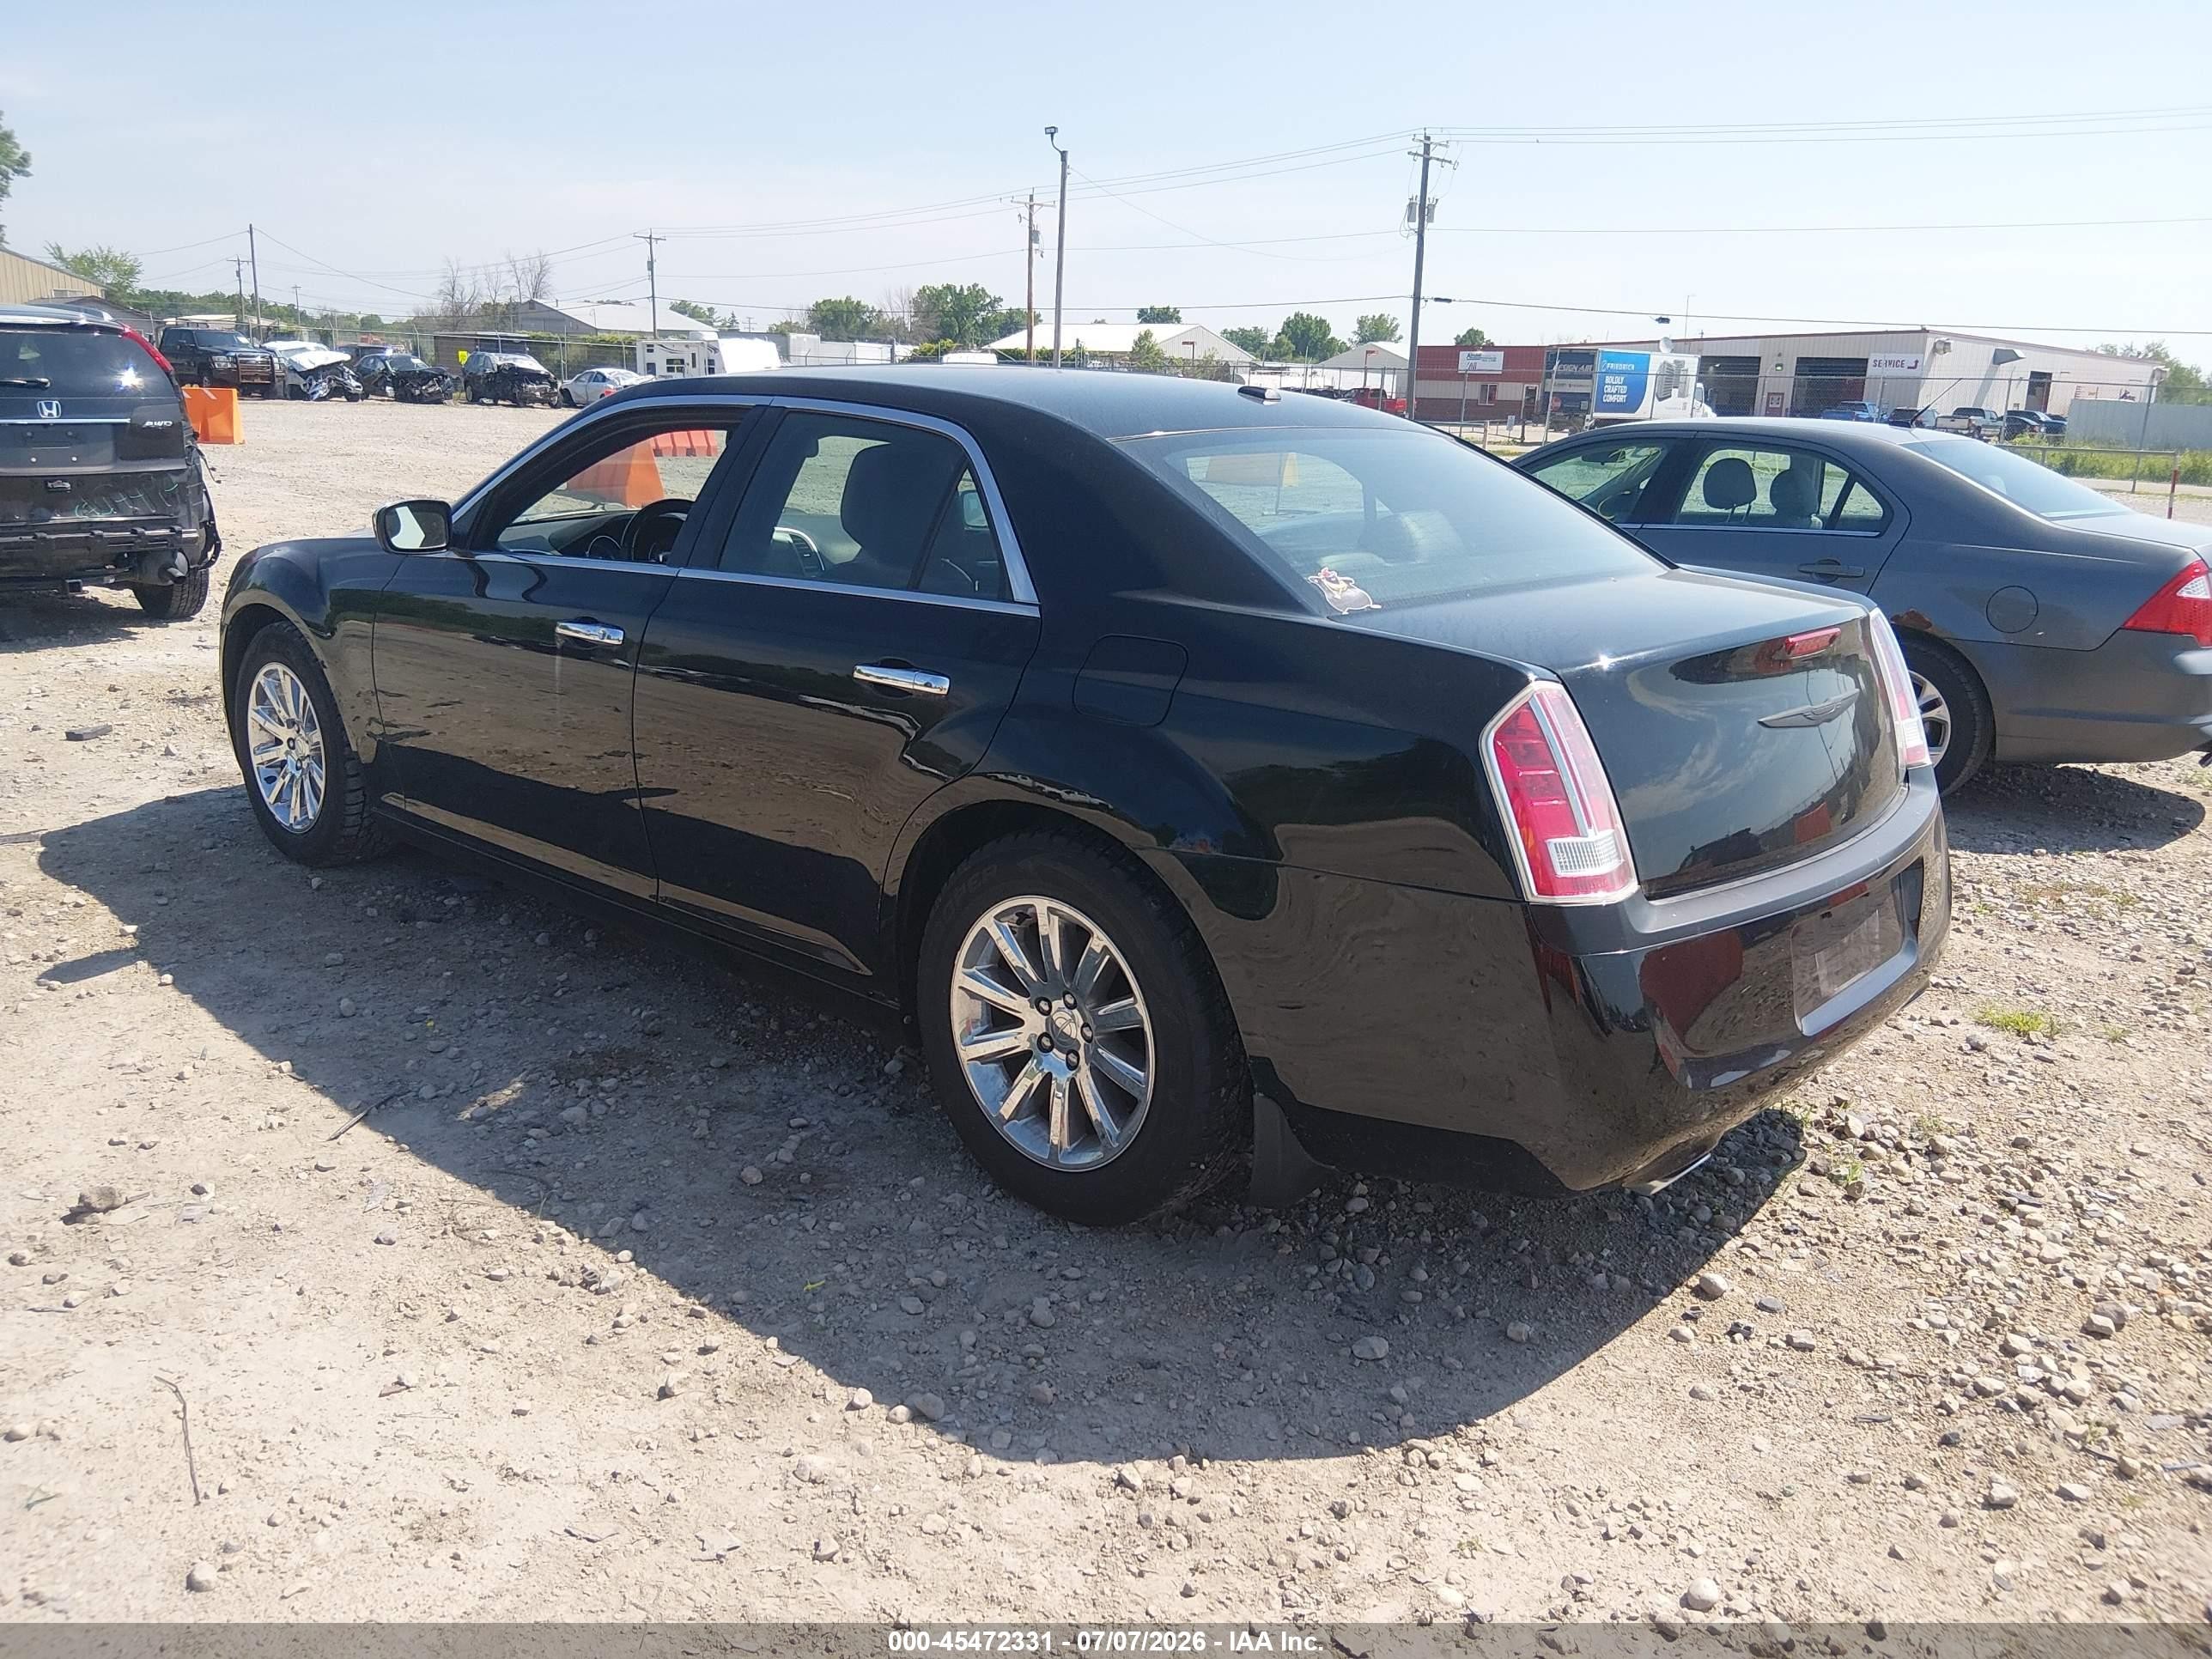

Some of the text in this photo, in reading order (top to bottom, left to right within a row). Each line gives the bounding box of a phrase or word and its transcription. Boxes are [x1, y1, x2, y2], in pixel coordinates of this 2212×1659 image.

[1607, 362, 1635, 371] FRIEDRICH
[1873, 359, 1905, 368] SERVICE
[1605, 375, 1625, 385] BOLDLY
[1604, 385, 1628, 394] CRAFTED
[1602, 394, 1627, 403] COMFORT
